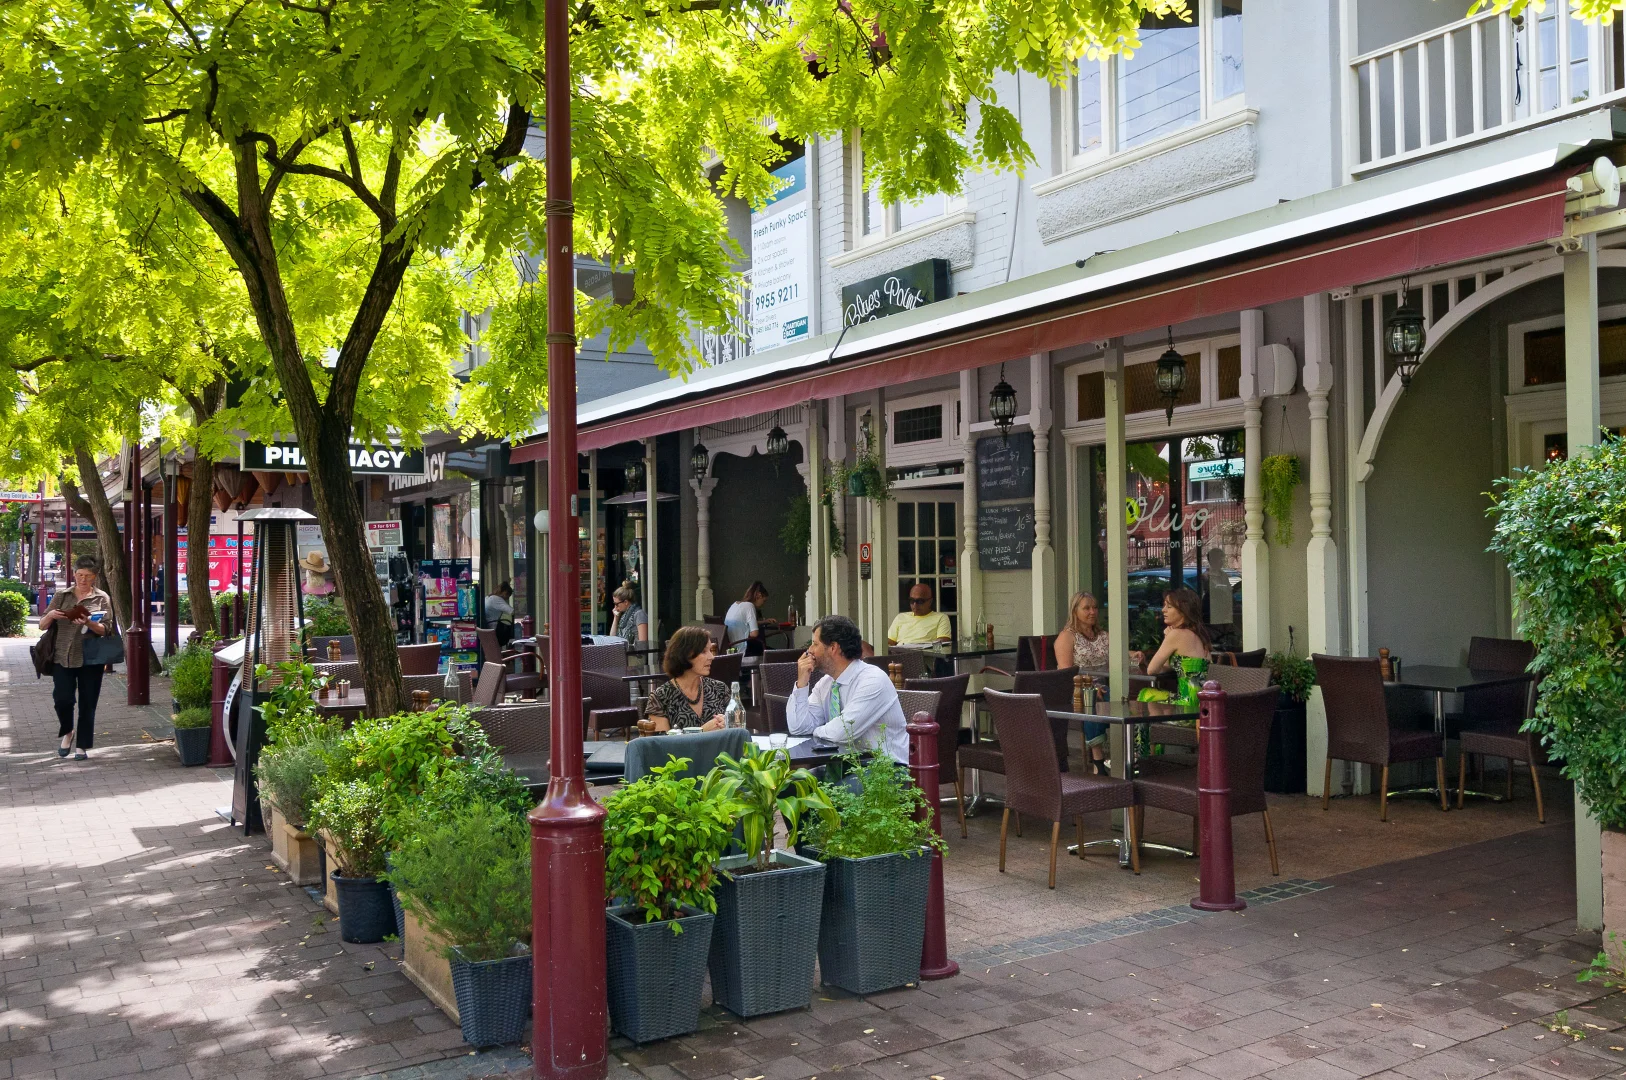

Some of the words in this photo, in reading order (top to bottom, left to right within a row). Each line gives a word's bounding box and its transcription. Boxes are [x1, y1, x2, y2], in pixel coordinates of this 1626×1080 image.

[753, 225, 768, 239] Fresh
[769, 218, 787, 232] Funky
[787, 209, 807, 224] Space
[755, 291, 776, 311] 9955
[777, 283, 798, 304] 9211
[844, 289, 881, 327] Blues
[265, 446, 406, 468] PHACY
[1170, 540, 1181, 549] on
